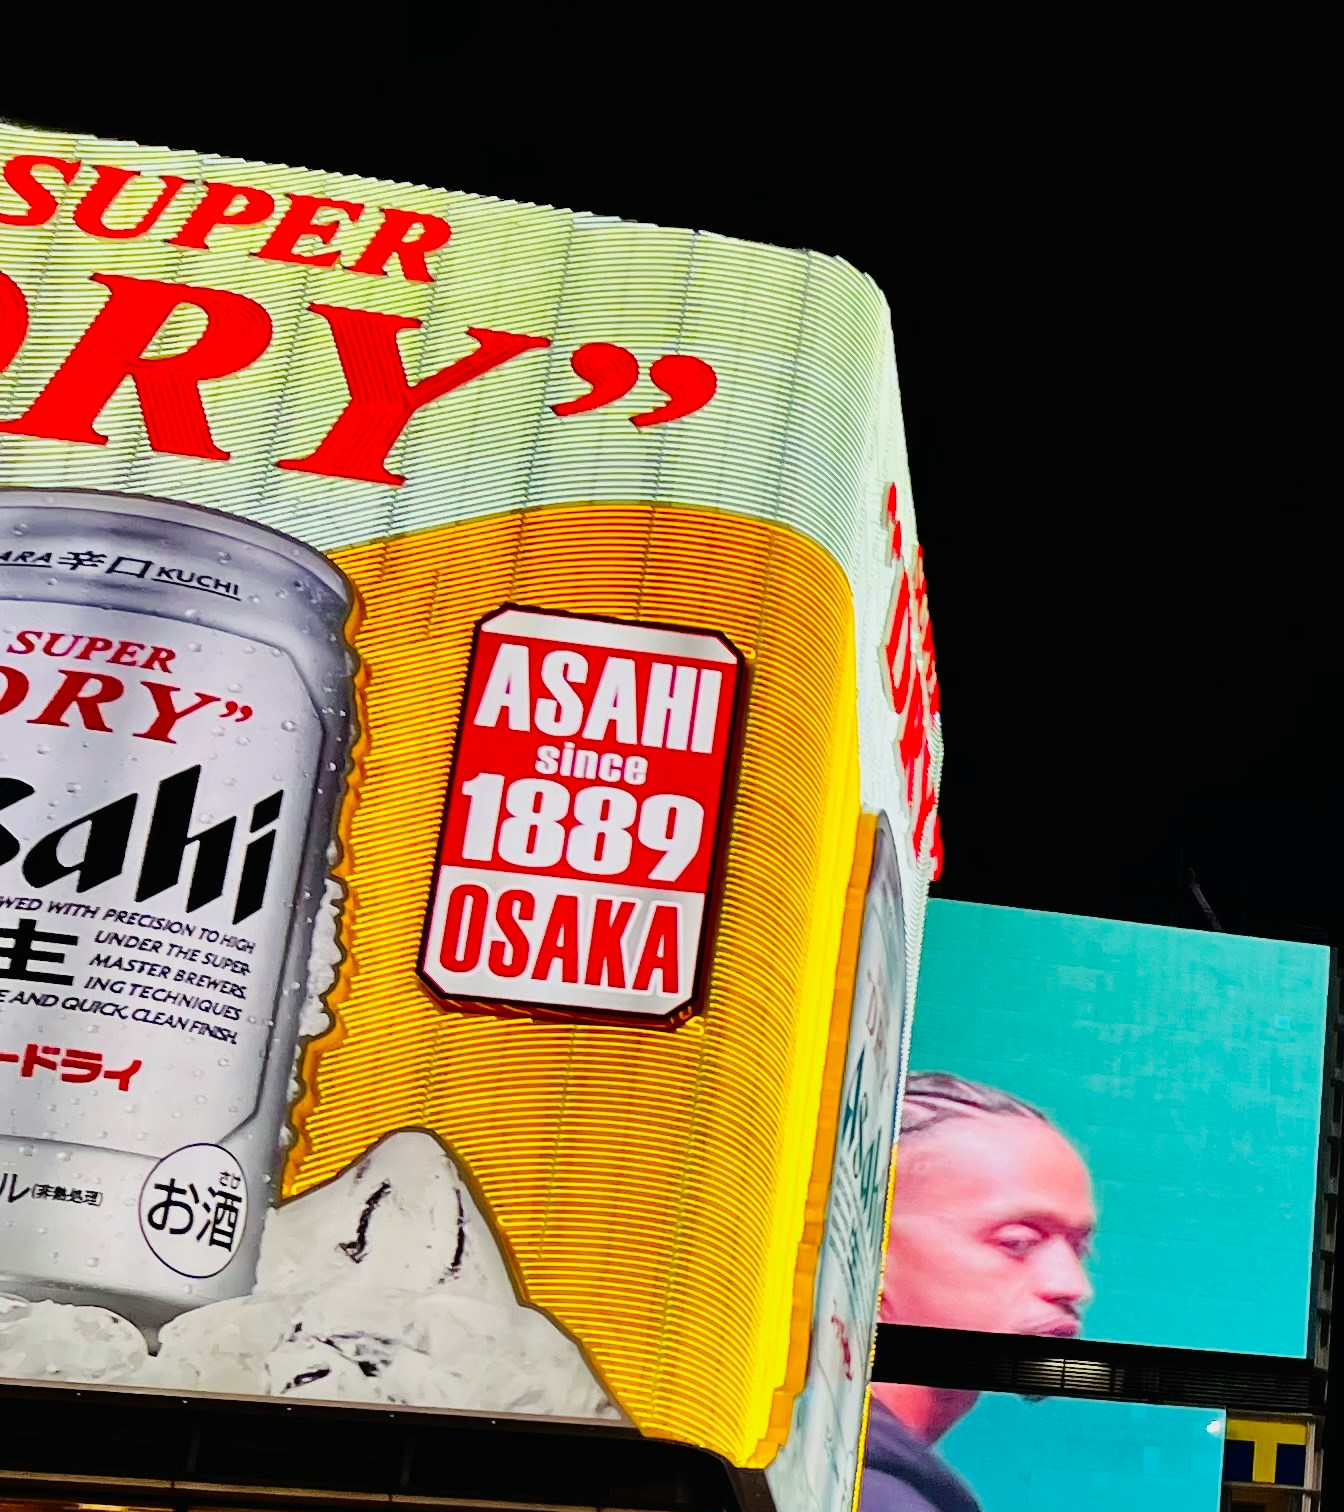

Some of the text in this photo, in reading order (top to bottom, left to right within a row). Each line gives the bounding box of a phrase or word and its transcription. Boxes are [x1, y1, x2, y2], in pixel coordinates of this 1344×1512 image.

[2, 154, 453, 284] SUPER
[0, 272, 717, 486] RY”
[57, 551, 154, 578] 辛口
[156, 566, 241, 596] KUCHI
[7, 630, 177, 673] SUPER
[474, 643, 724, 755] ASAHI
[534, 743, 650, 785] since
[459, 772, 707, 884] 1889
[49, 901, 100, 919] WITH
[103, 908, 196, 938] PRECISION
[199, 927, 221, 943] TO
[439, 883, 684, 995] OSAKA
[89, 953, 172, 980] MASTER
[94, 930, 201, 963] UNDER THE
[14, 990, 60, 1008] AND
[131, 1007, 189, 1033] CLEAN
[83, 975, 243, 1022] ING TECHNIQUES
[147, 1178, 243, 1253] お酒
